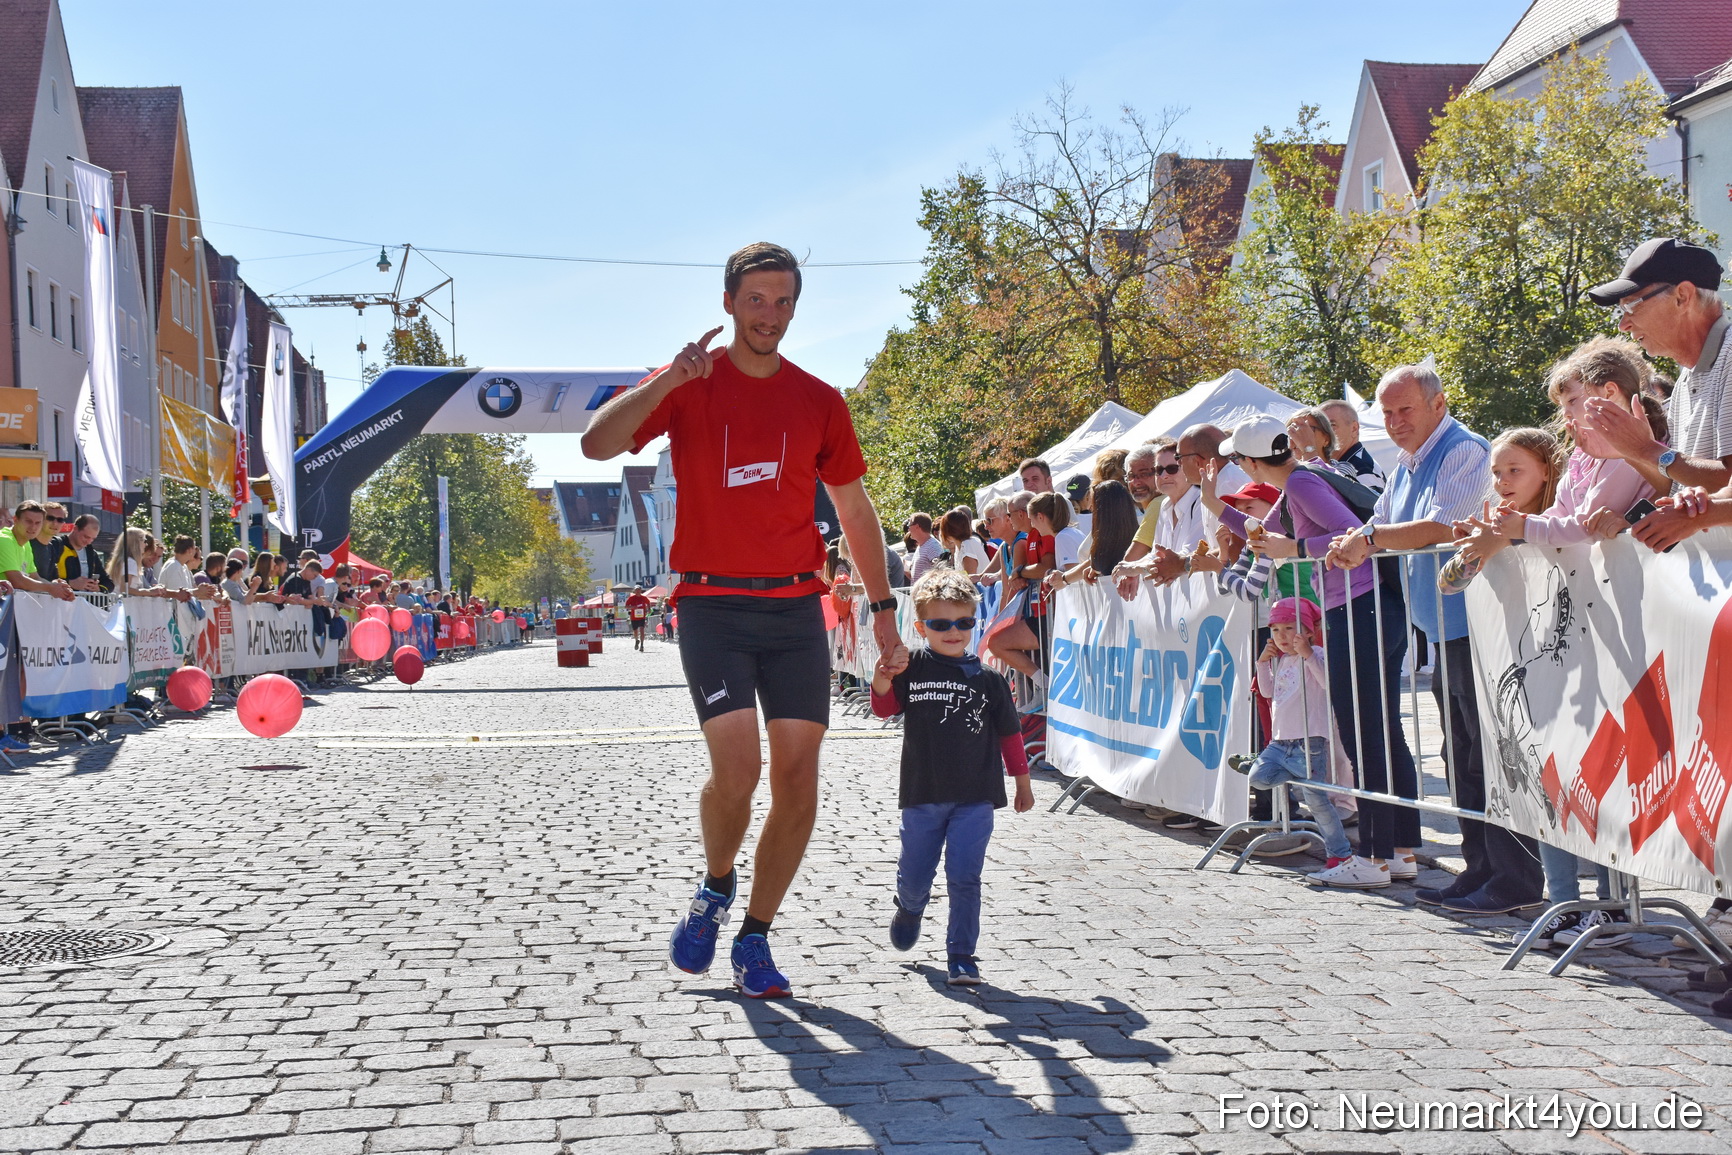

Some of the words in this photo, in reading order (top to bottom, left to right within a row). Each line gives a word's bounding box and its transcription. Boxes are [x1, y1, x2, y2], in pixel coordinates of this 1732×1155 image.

[482, 377, 518, 391] BMW
[303, 447, 343, 474] PARTL
[340, 409, 404, 453] NEUMARKT
[743, 467, 763, 480] DEHN
[909, 680, 968, 691] Neumarkter
[909, 691, 955, 703] Stadtlauf
[1684, 713, 1726, 824] Braun
[1570, 765, 1597, 821] Braun
[1628, 750, 1673, 824] Braun
